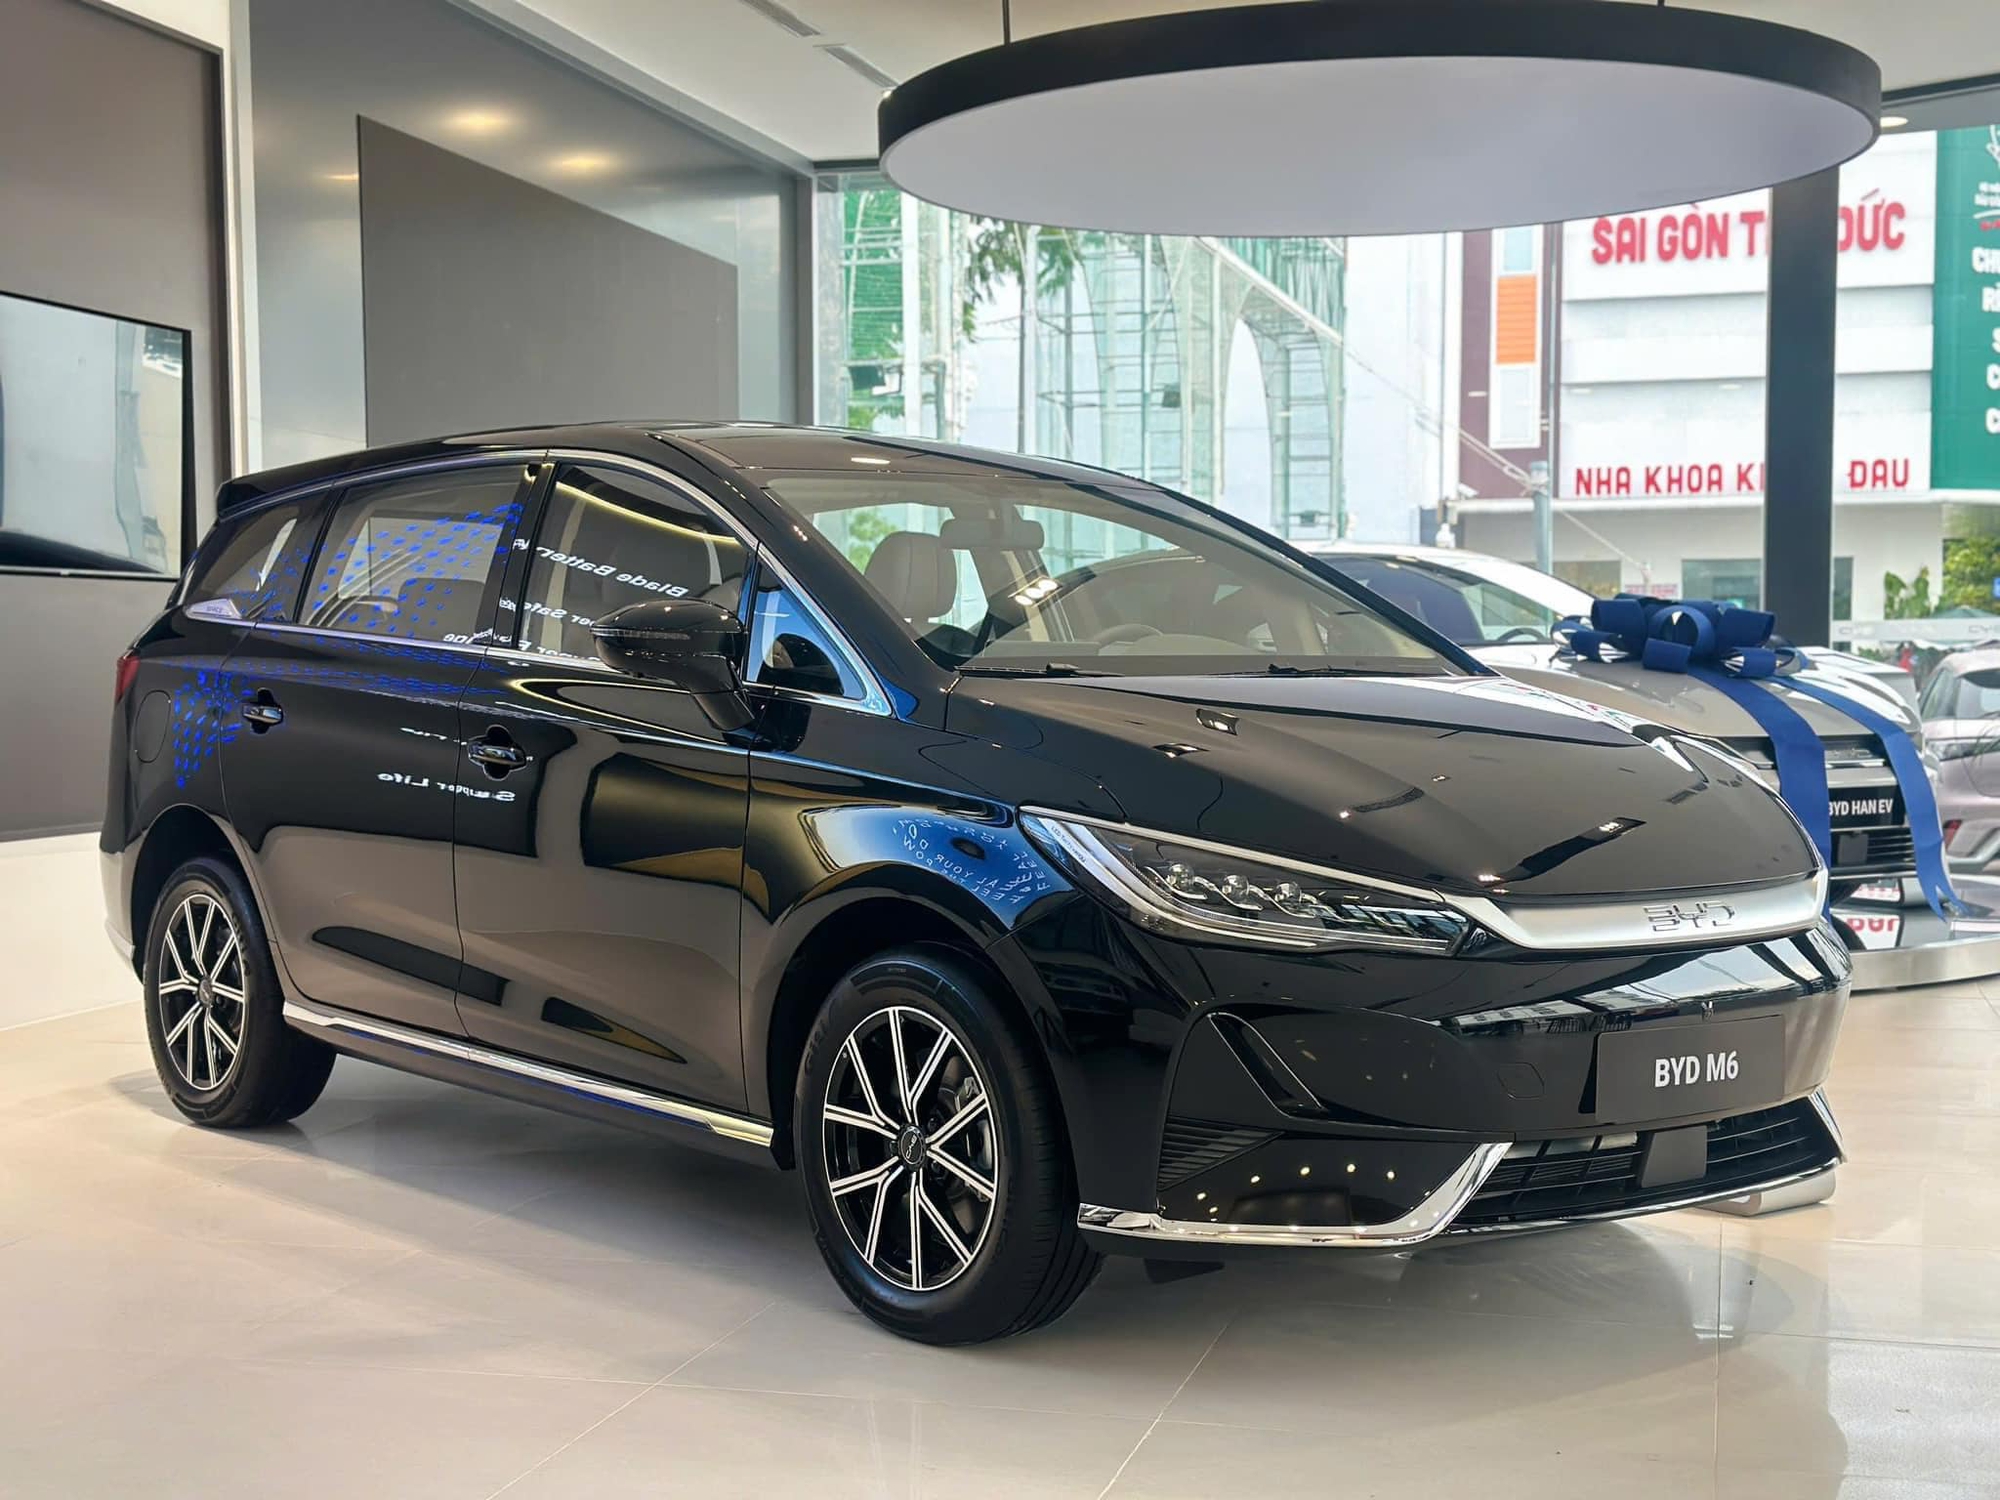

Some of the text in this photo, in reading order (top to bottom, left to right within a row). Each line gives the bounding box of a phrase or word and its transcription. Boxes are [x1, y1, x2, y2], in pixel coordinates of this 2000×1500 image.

[1592, 215, 1646, 264] SAI
[1657, 203, 1729, 262] GÒN
[1576, 466, 1631, 495] NHA
[1645, 464, 1724, 494] KHOA
[1846, 459, 1910, 489] ĐAU
[1852, 799, 1877, 815] HAN
[1880, 799, 1893, 814] EV
[1644, 901, 1735, 932] BYD
[1654, 1051, 1739, 1087] BYD M6
